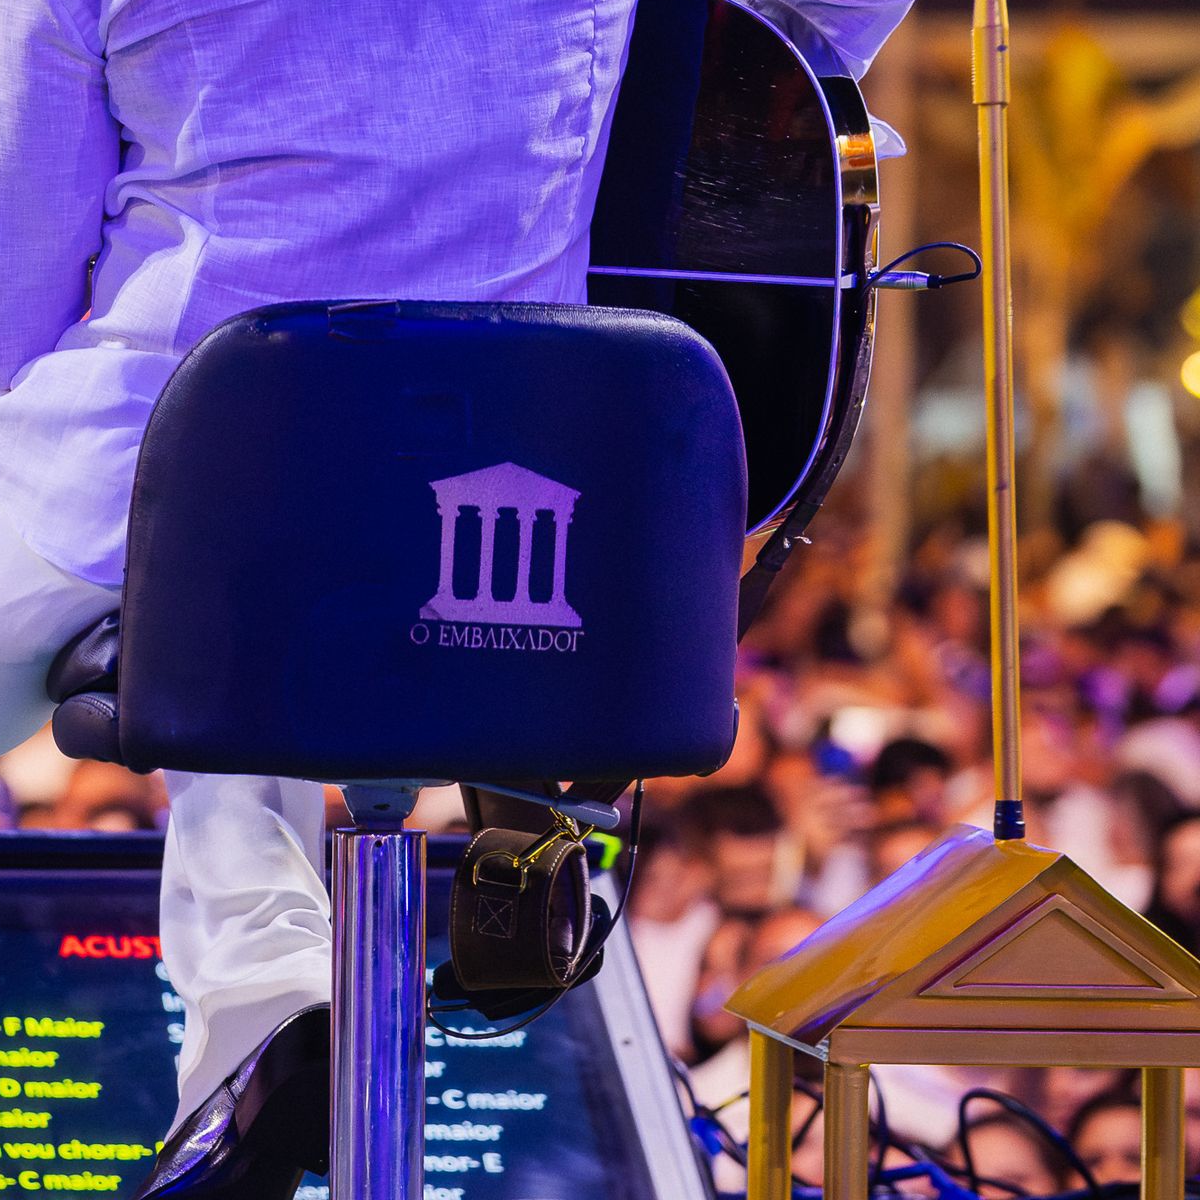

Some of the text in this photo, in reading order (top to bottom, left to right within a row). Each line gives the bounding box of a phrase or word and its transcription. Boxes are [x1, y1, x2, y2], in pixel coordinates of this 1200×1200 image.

[410, 623, 430, 644] O
[3, 1016, 21, 1037] F
[442, 1088, 466, 1110] C
[3, 1142, 56, 1159] vou
[482, 1152, 505, 1173] E
[18, 1171, 41, 1190] C
